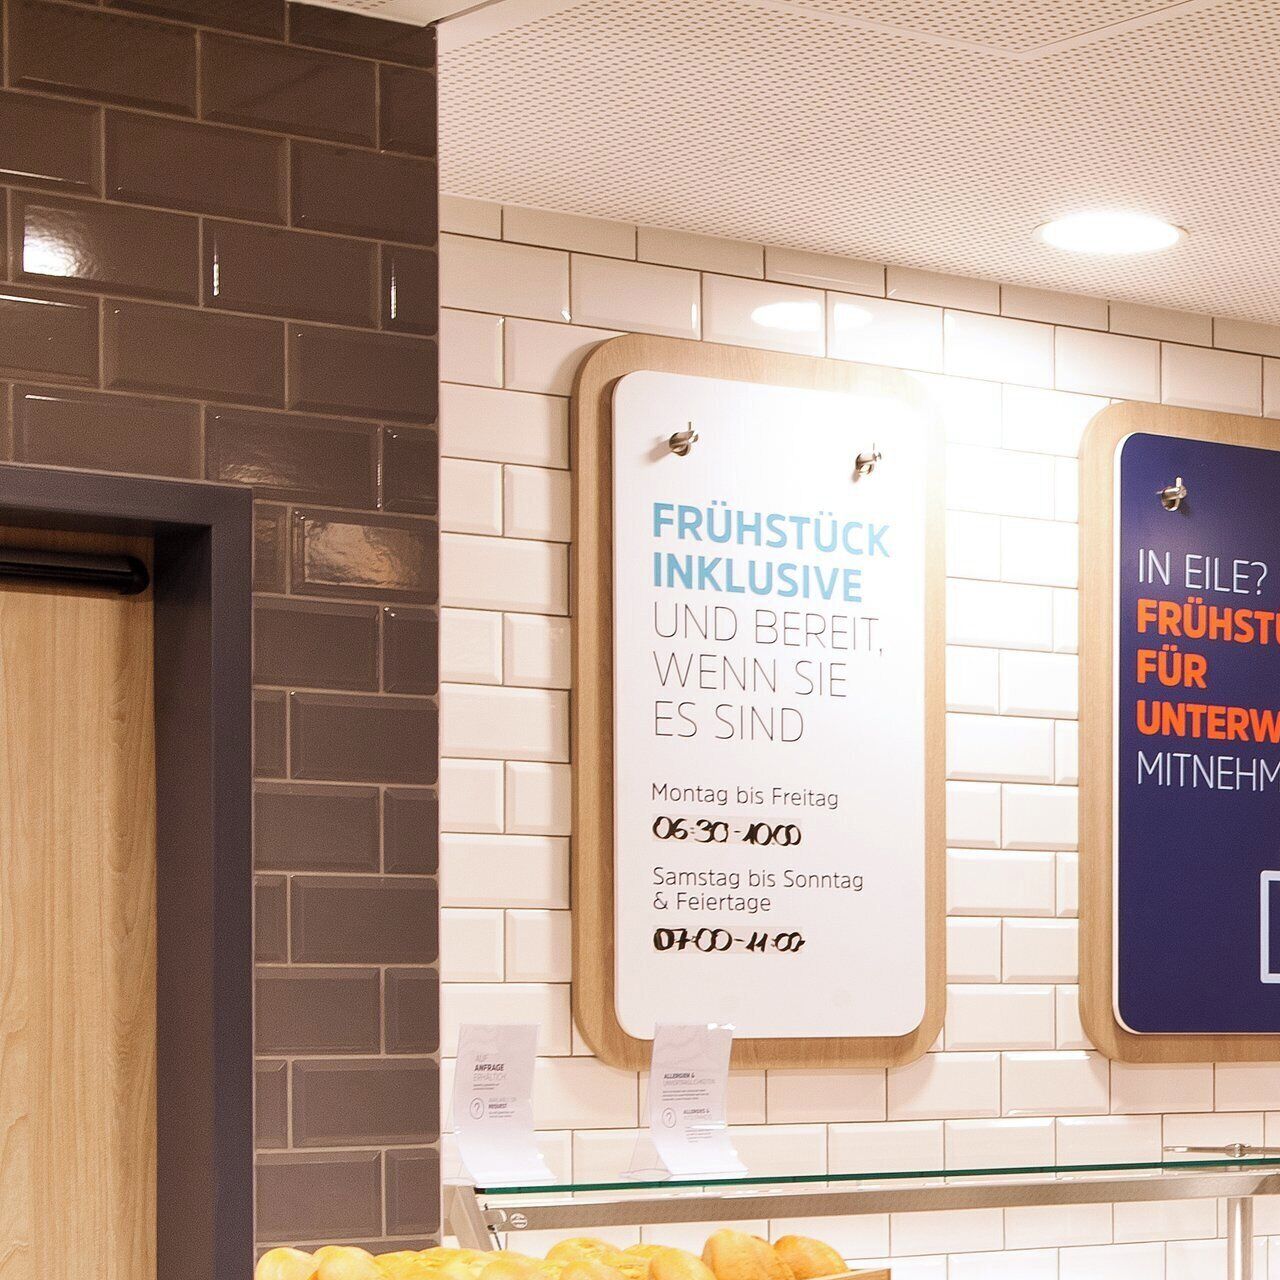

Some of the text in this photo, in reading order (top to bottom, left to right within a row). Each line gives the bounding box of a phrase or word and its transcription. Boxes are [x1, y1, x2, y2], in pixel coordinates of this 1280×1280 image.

[653, 500, 890, 557] FRÜHSTÜCK
[653, 552, 862, 602] INKLUSIVE
[1138, 547, 1268, 595] IN EILE?
[653, 601, 884, 655] UND BEREIT,
[653, 650, 848, 699] WENN SIE
[1137, 644, 1207, 688] FÜR
[654, 700, 804, 743] ES SIND
[652, 783, 839, 810] Montag bis Freitag
[653, 866, 864, 891] Samstag bis Sonntag
[653, 891, 771, 914] & Feiertage
